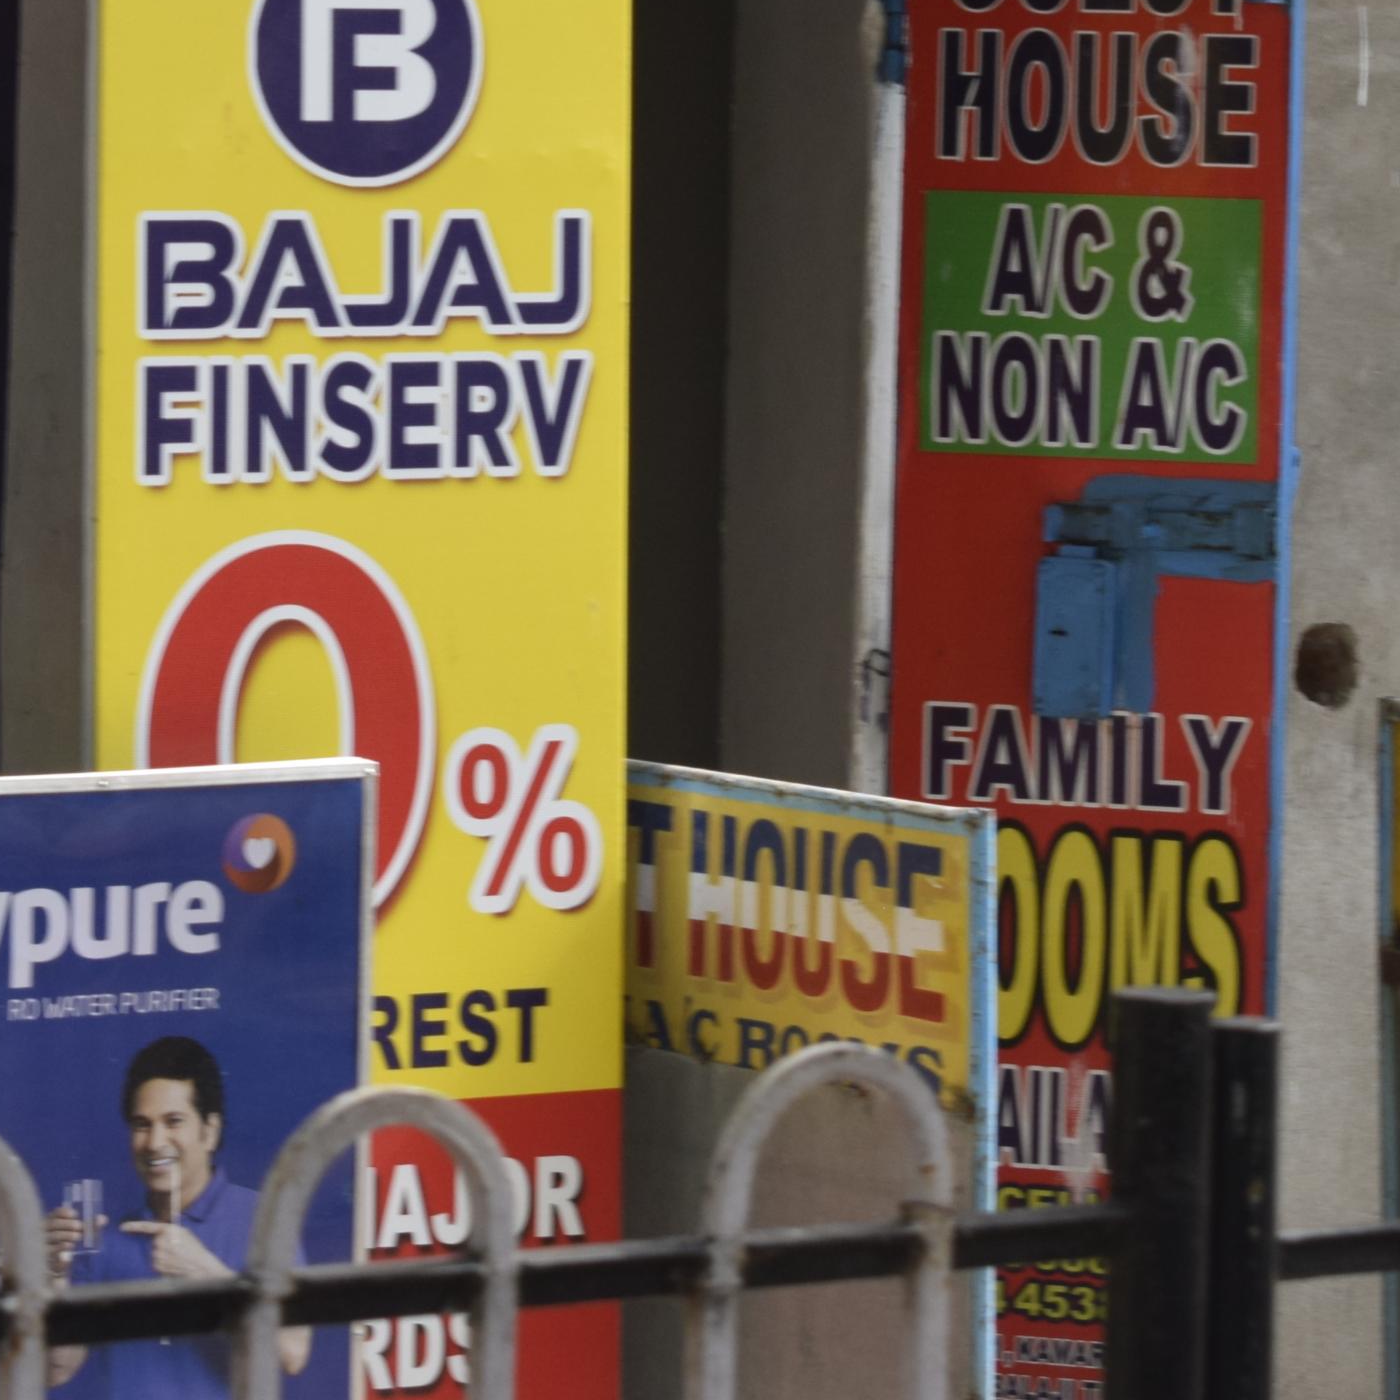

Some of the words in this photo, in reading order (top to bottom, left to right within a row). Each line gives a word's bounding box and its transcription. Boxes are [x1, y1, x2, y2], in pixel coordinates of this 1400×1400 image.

[936, 26, 1260, 167] HOUSE
[136, 208, 593, 342] BAJAJ
[1131, 207, 1196, 323] &
[136, 349, 592, 488] FINSERV
[932, 330, 1100, 449] NON
[921, 701, 1253, 814] FAMILY
[688, 809, 946, 1023] HOUSE
[996, 817, 1245, 1051] OOMS
[6, 996, 39, 1023] RO
[43, 992, 116, 1020] WATER
[119, 987, 221, 1016] PURIFIER
[371, 987, 549, 1070] REST
[365, 1155, 586, 1249] AJR
